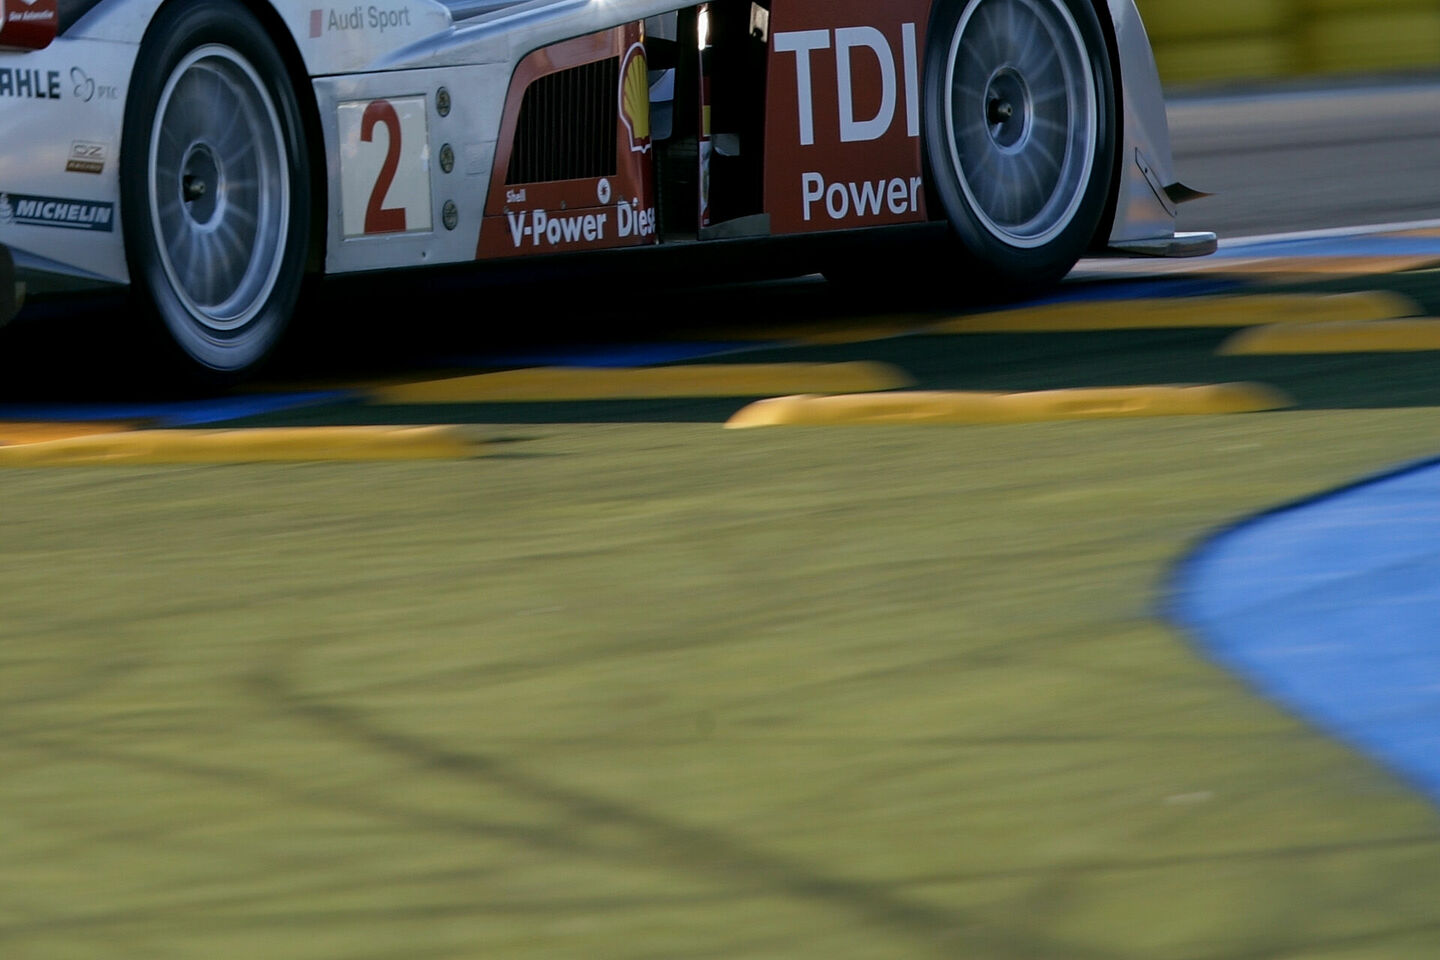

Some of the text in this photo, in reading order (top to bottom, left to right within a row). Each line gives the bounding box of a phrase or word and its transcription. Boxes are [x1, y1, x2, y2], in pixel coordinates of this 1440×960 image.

[328, 5, 410, 32] Audi Sport
[773, 22, 920, 146] TDI
[360, 99, 406, 235] 2
[16, 200, 112, 223] MICHELIN
[801, 172, 922, 221] Power
[508, 209, 607, 247] V-Power
